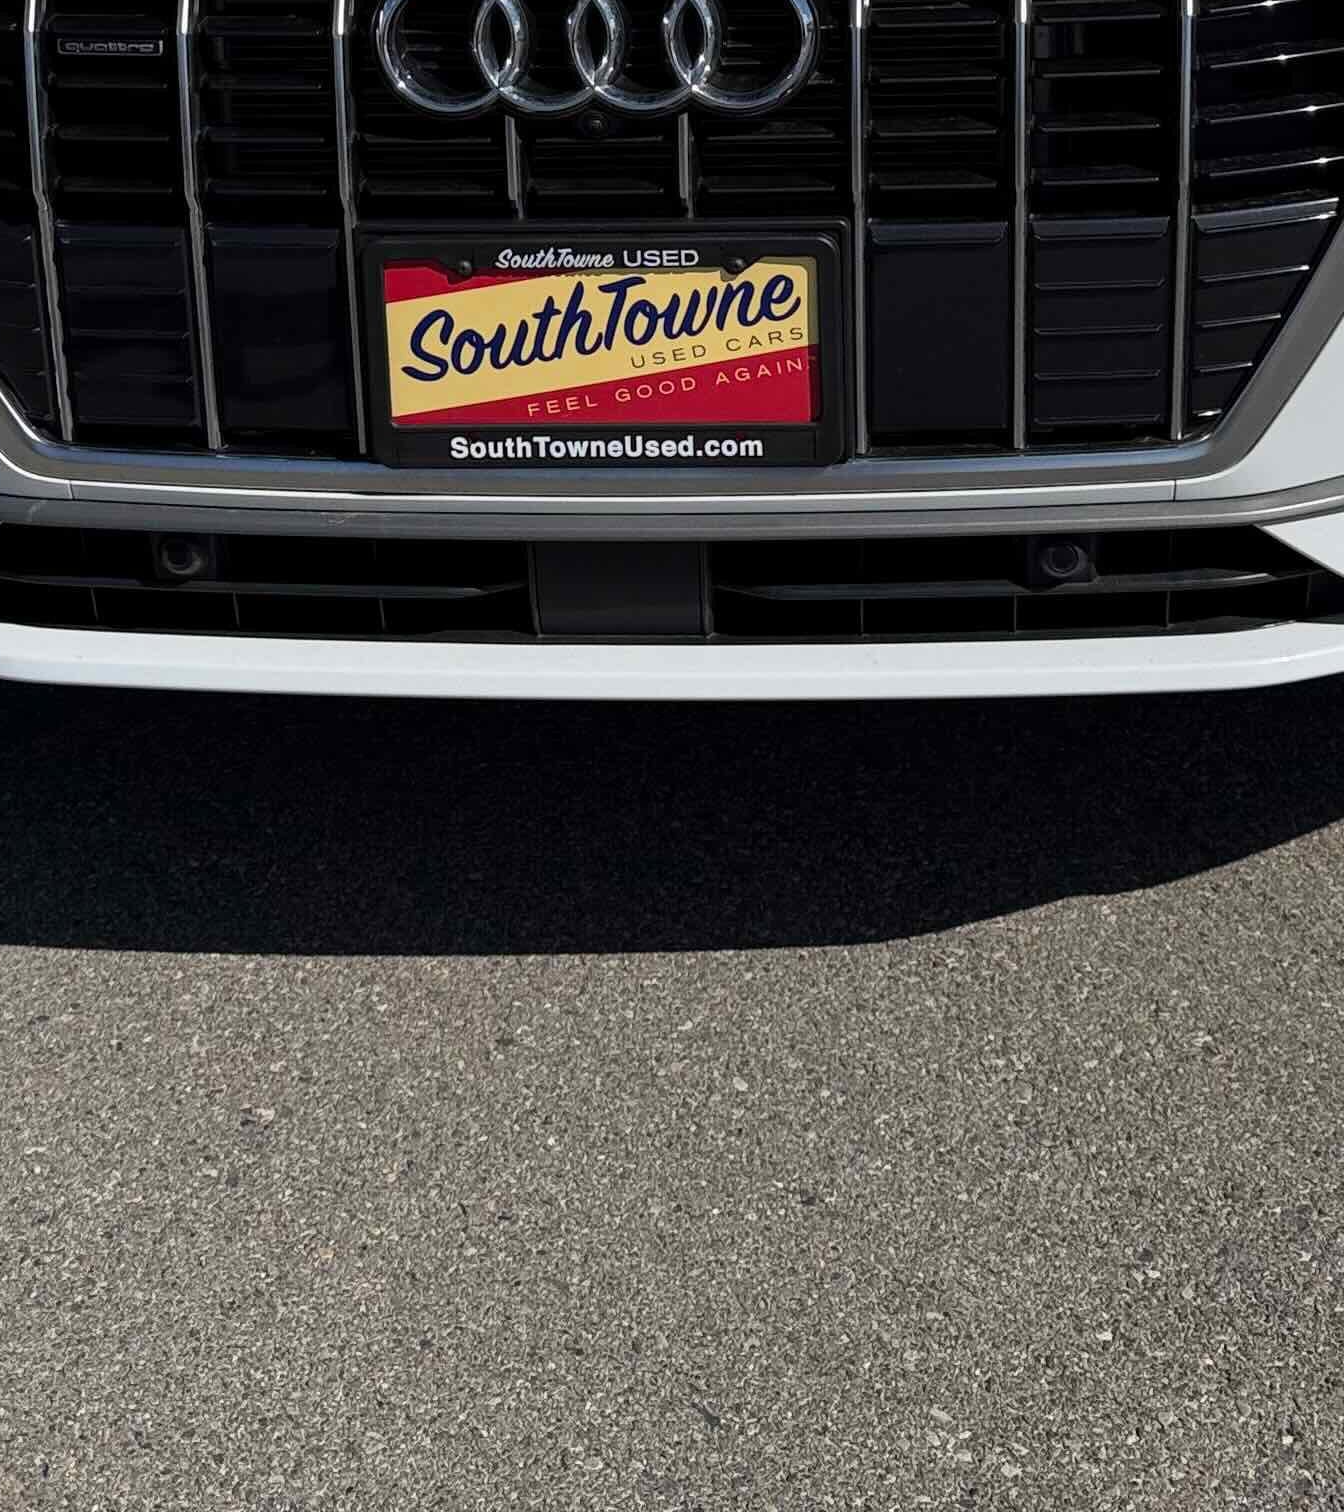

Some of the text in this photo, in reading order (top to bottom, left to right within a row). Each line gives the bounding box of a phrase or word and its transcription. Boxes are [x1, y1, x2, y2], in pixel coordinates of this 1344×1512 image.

[495, 247, 699, 269] SouthTowne USED
[401, 274, 801, 382] SouthTowne
[630, 327, 804, 369] USED CARS
[527, 394, 598, 417] FEEL
[614, 376, 697, 403] GOOD
[450, 435, 764, 459] SouthTowneUsed.com
